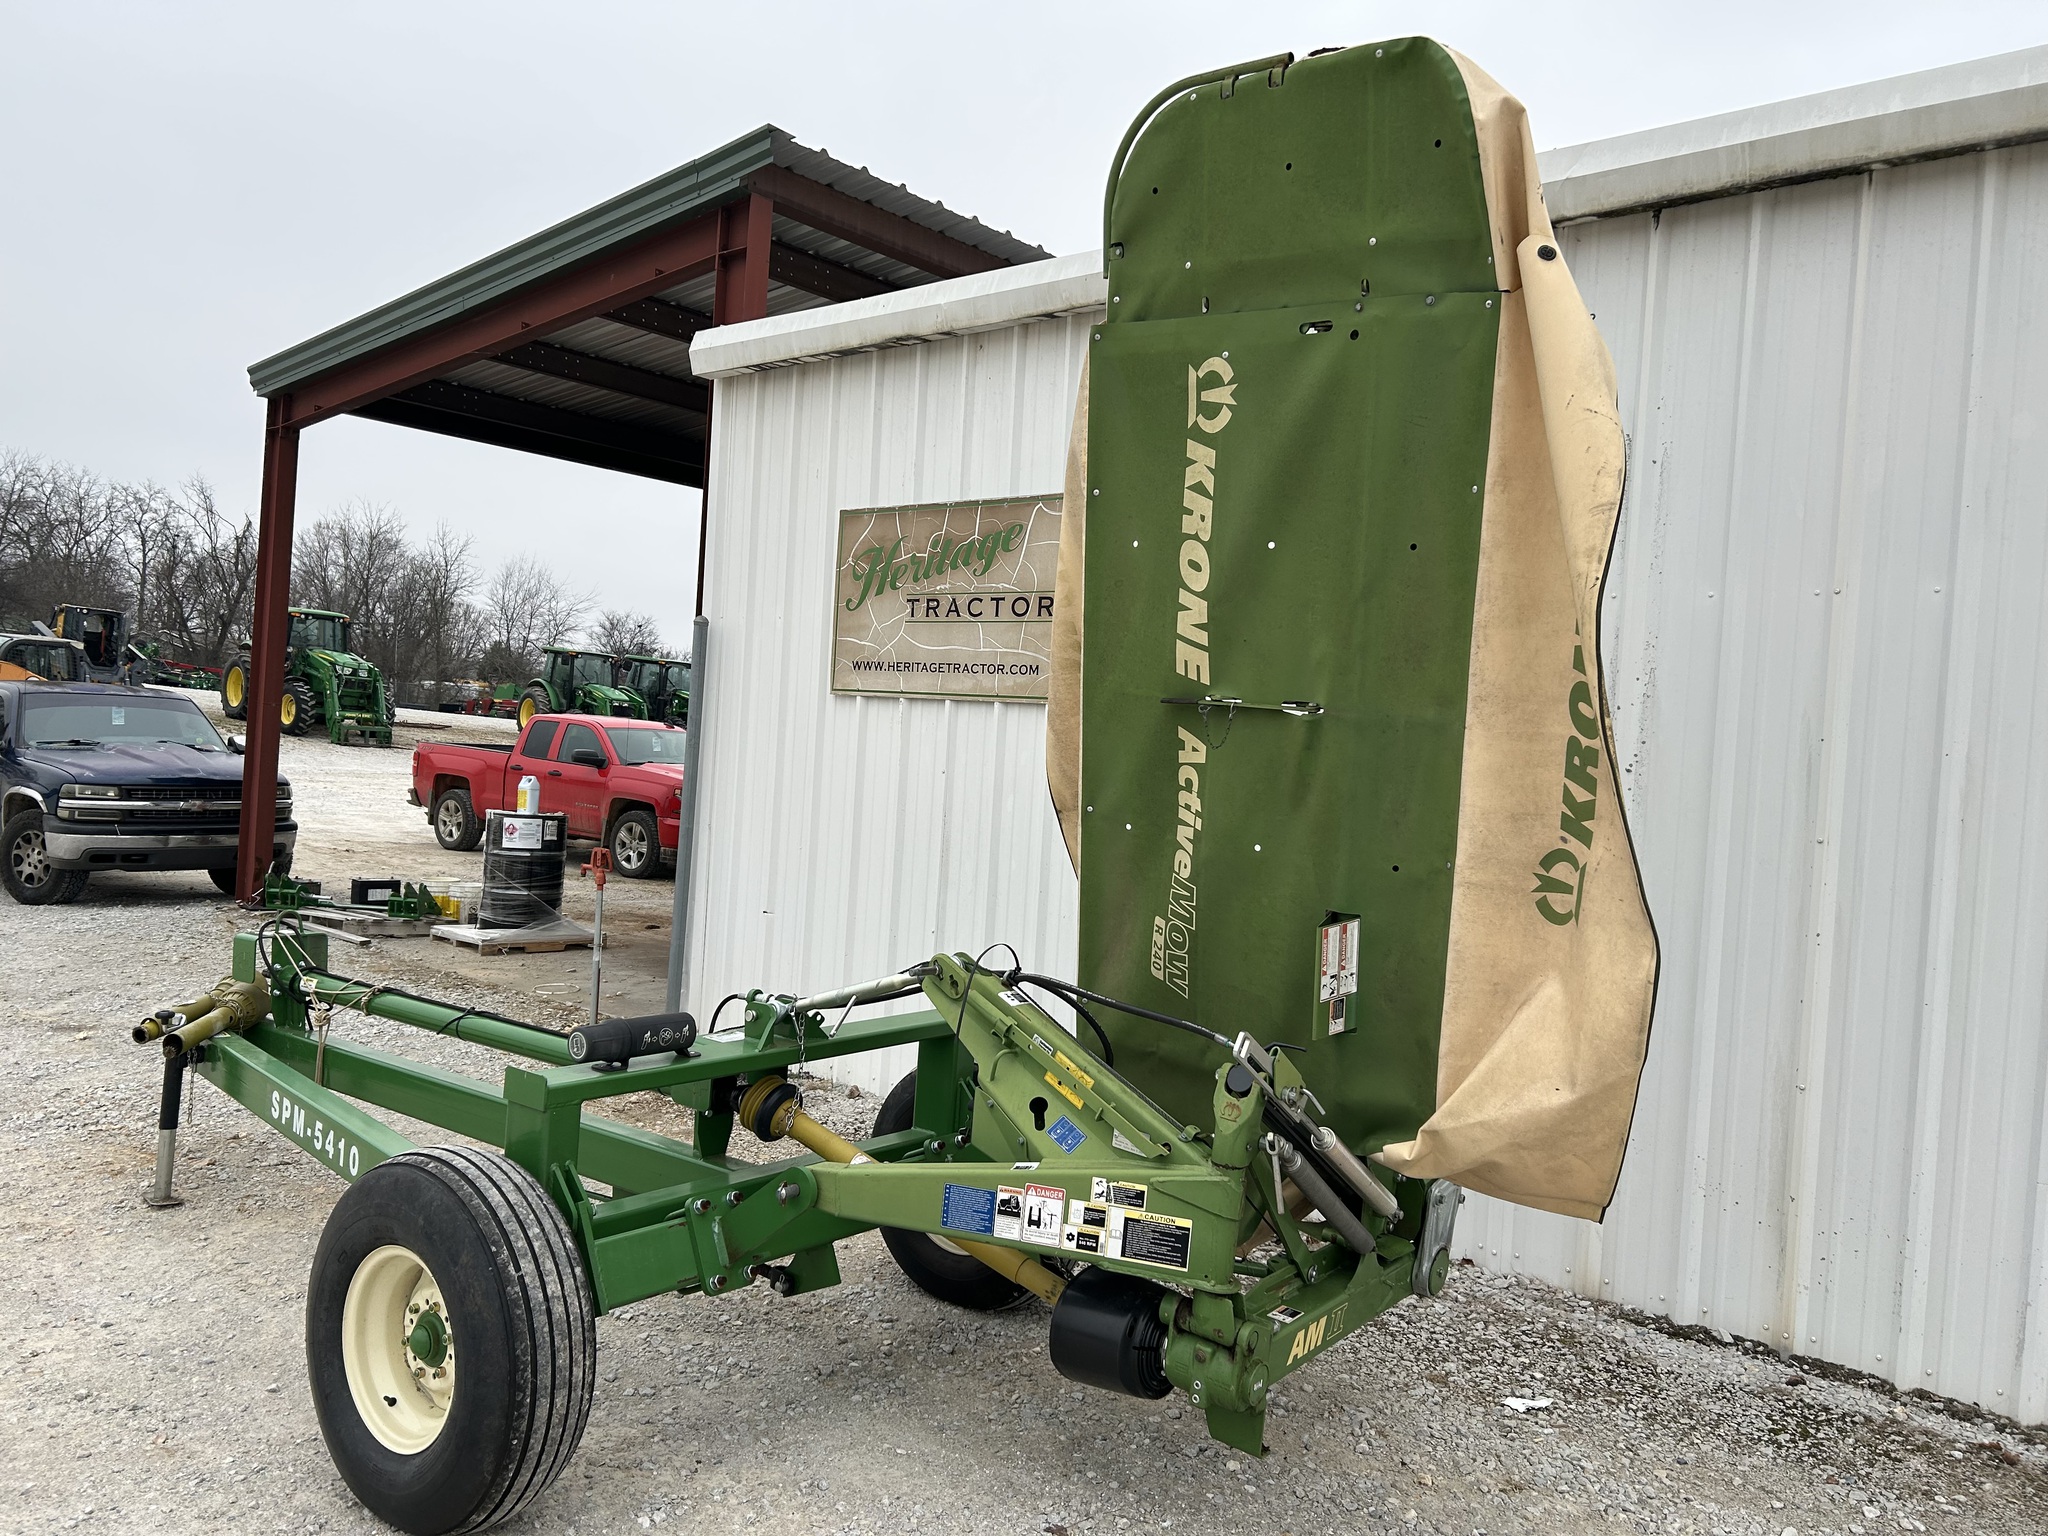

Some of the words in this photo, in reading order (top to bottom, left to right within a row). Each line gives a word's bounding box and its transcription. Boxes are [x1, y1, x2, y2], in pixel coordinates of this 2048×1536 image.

[845, 523, 1024, 612] Heritage
[1175, 438, 1216, 686] KRONE
[907, 596, 1054, 618] TRACTOR
[851, 660, 1040, 676] WWW.HERITAGETRACTOR.COM
[1560, 618, 1599, 850] KRO
[1165, 725, 1207, 999] ActiveMow
[1154, 923, 1164, 937] R
[1152, 939, 1163, 971] 240
[271, 1090, 359, 1176] SPM-5410
[1036, 1187, 1063, 1200] DANGER
[1144, 1213, 1176, 1225] CAUTION
[1286, 1315, 1328, 1366] AM
